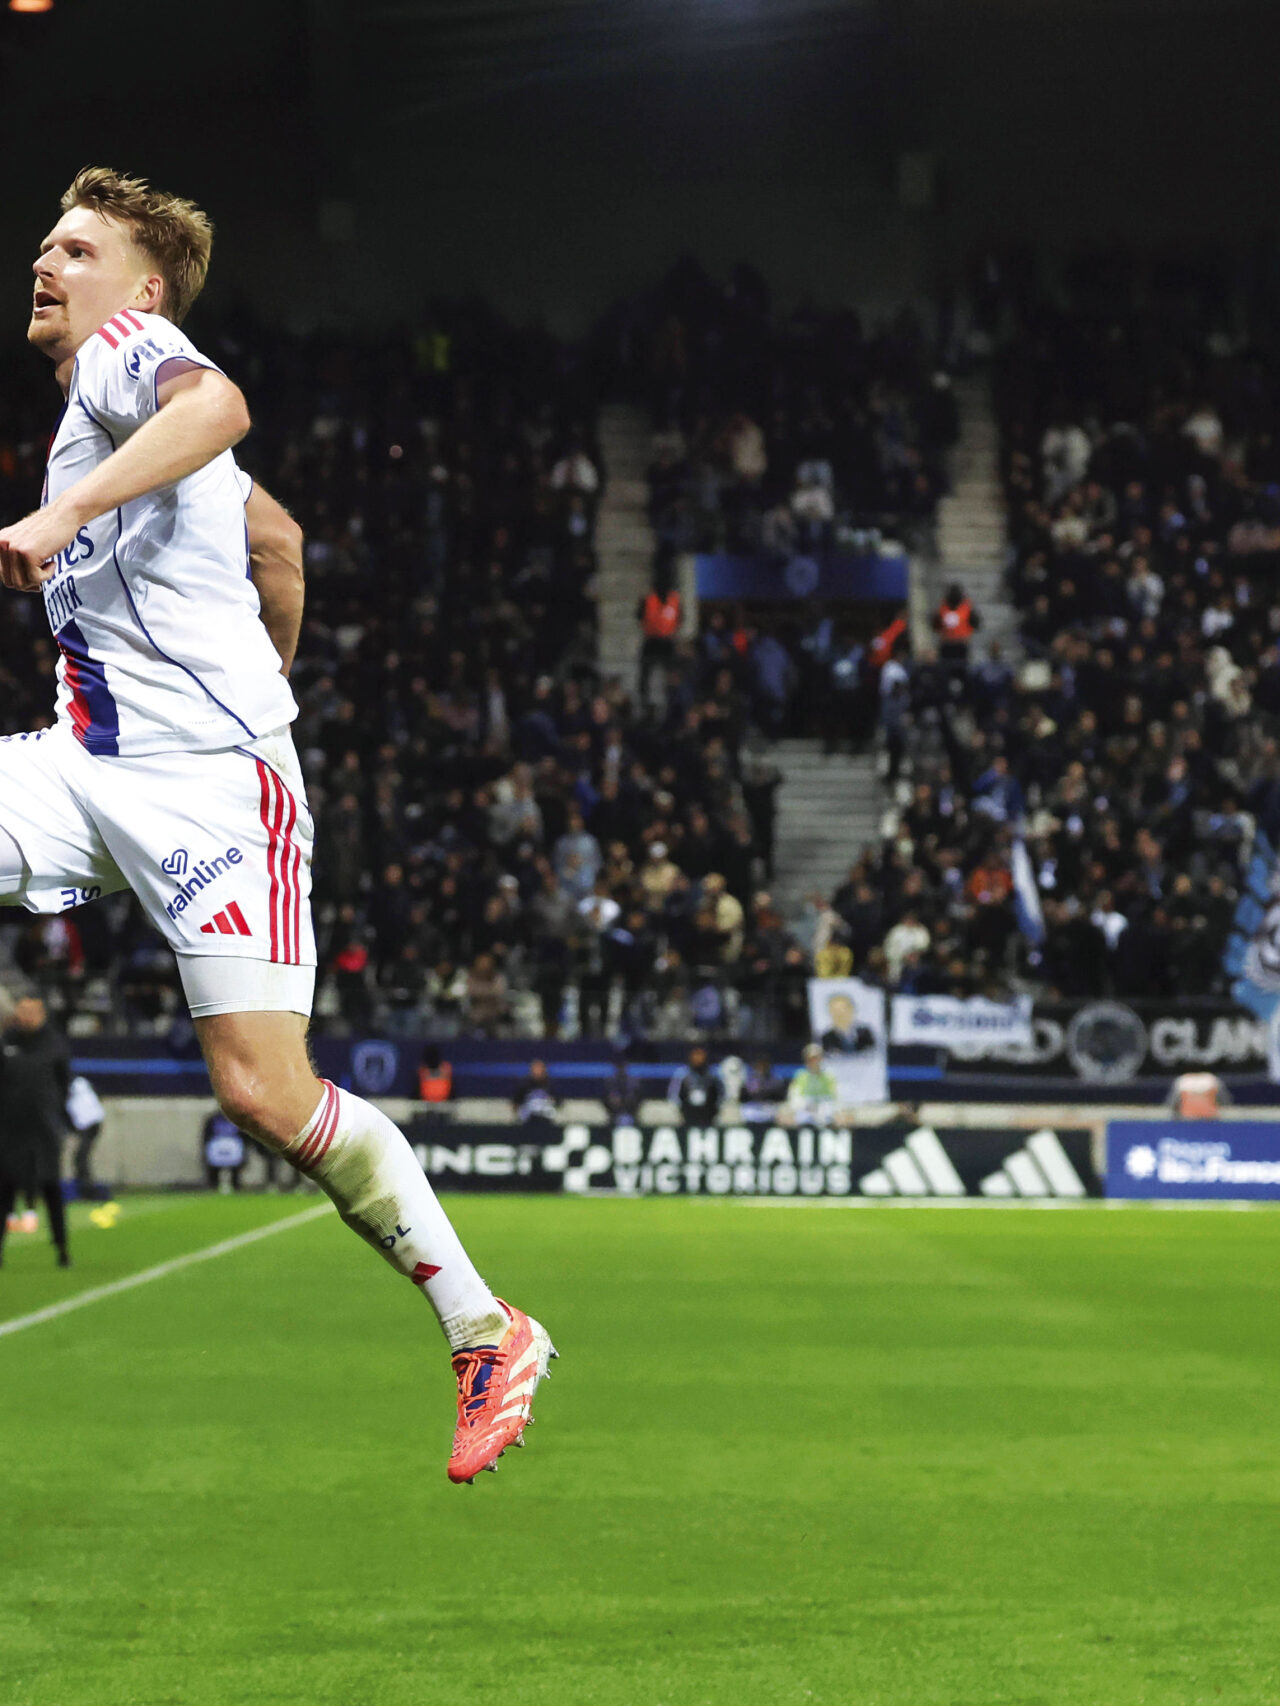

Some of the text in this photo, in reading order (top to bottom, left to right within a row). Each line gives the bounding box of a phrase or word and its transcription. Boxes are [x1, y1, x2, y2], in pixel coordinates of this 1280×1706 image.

[47, 574, 83, 632] ETTER
[166, 847, 244, 920] rainline
[612, 1127, 853, 1165] BAHRAIN
[613, 1164, 852, 1195] VICTORIOUS
[380, 1224, 412, 1250] OL
